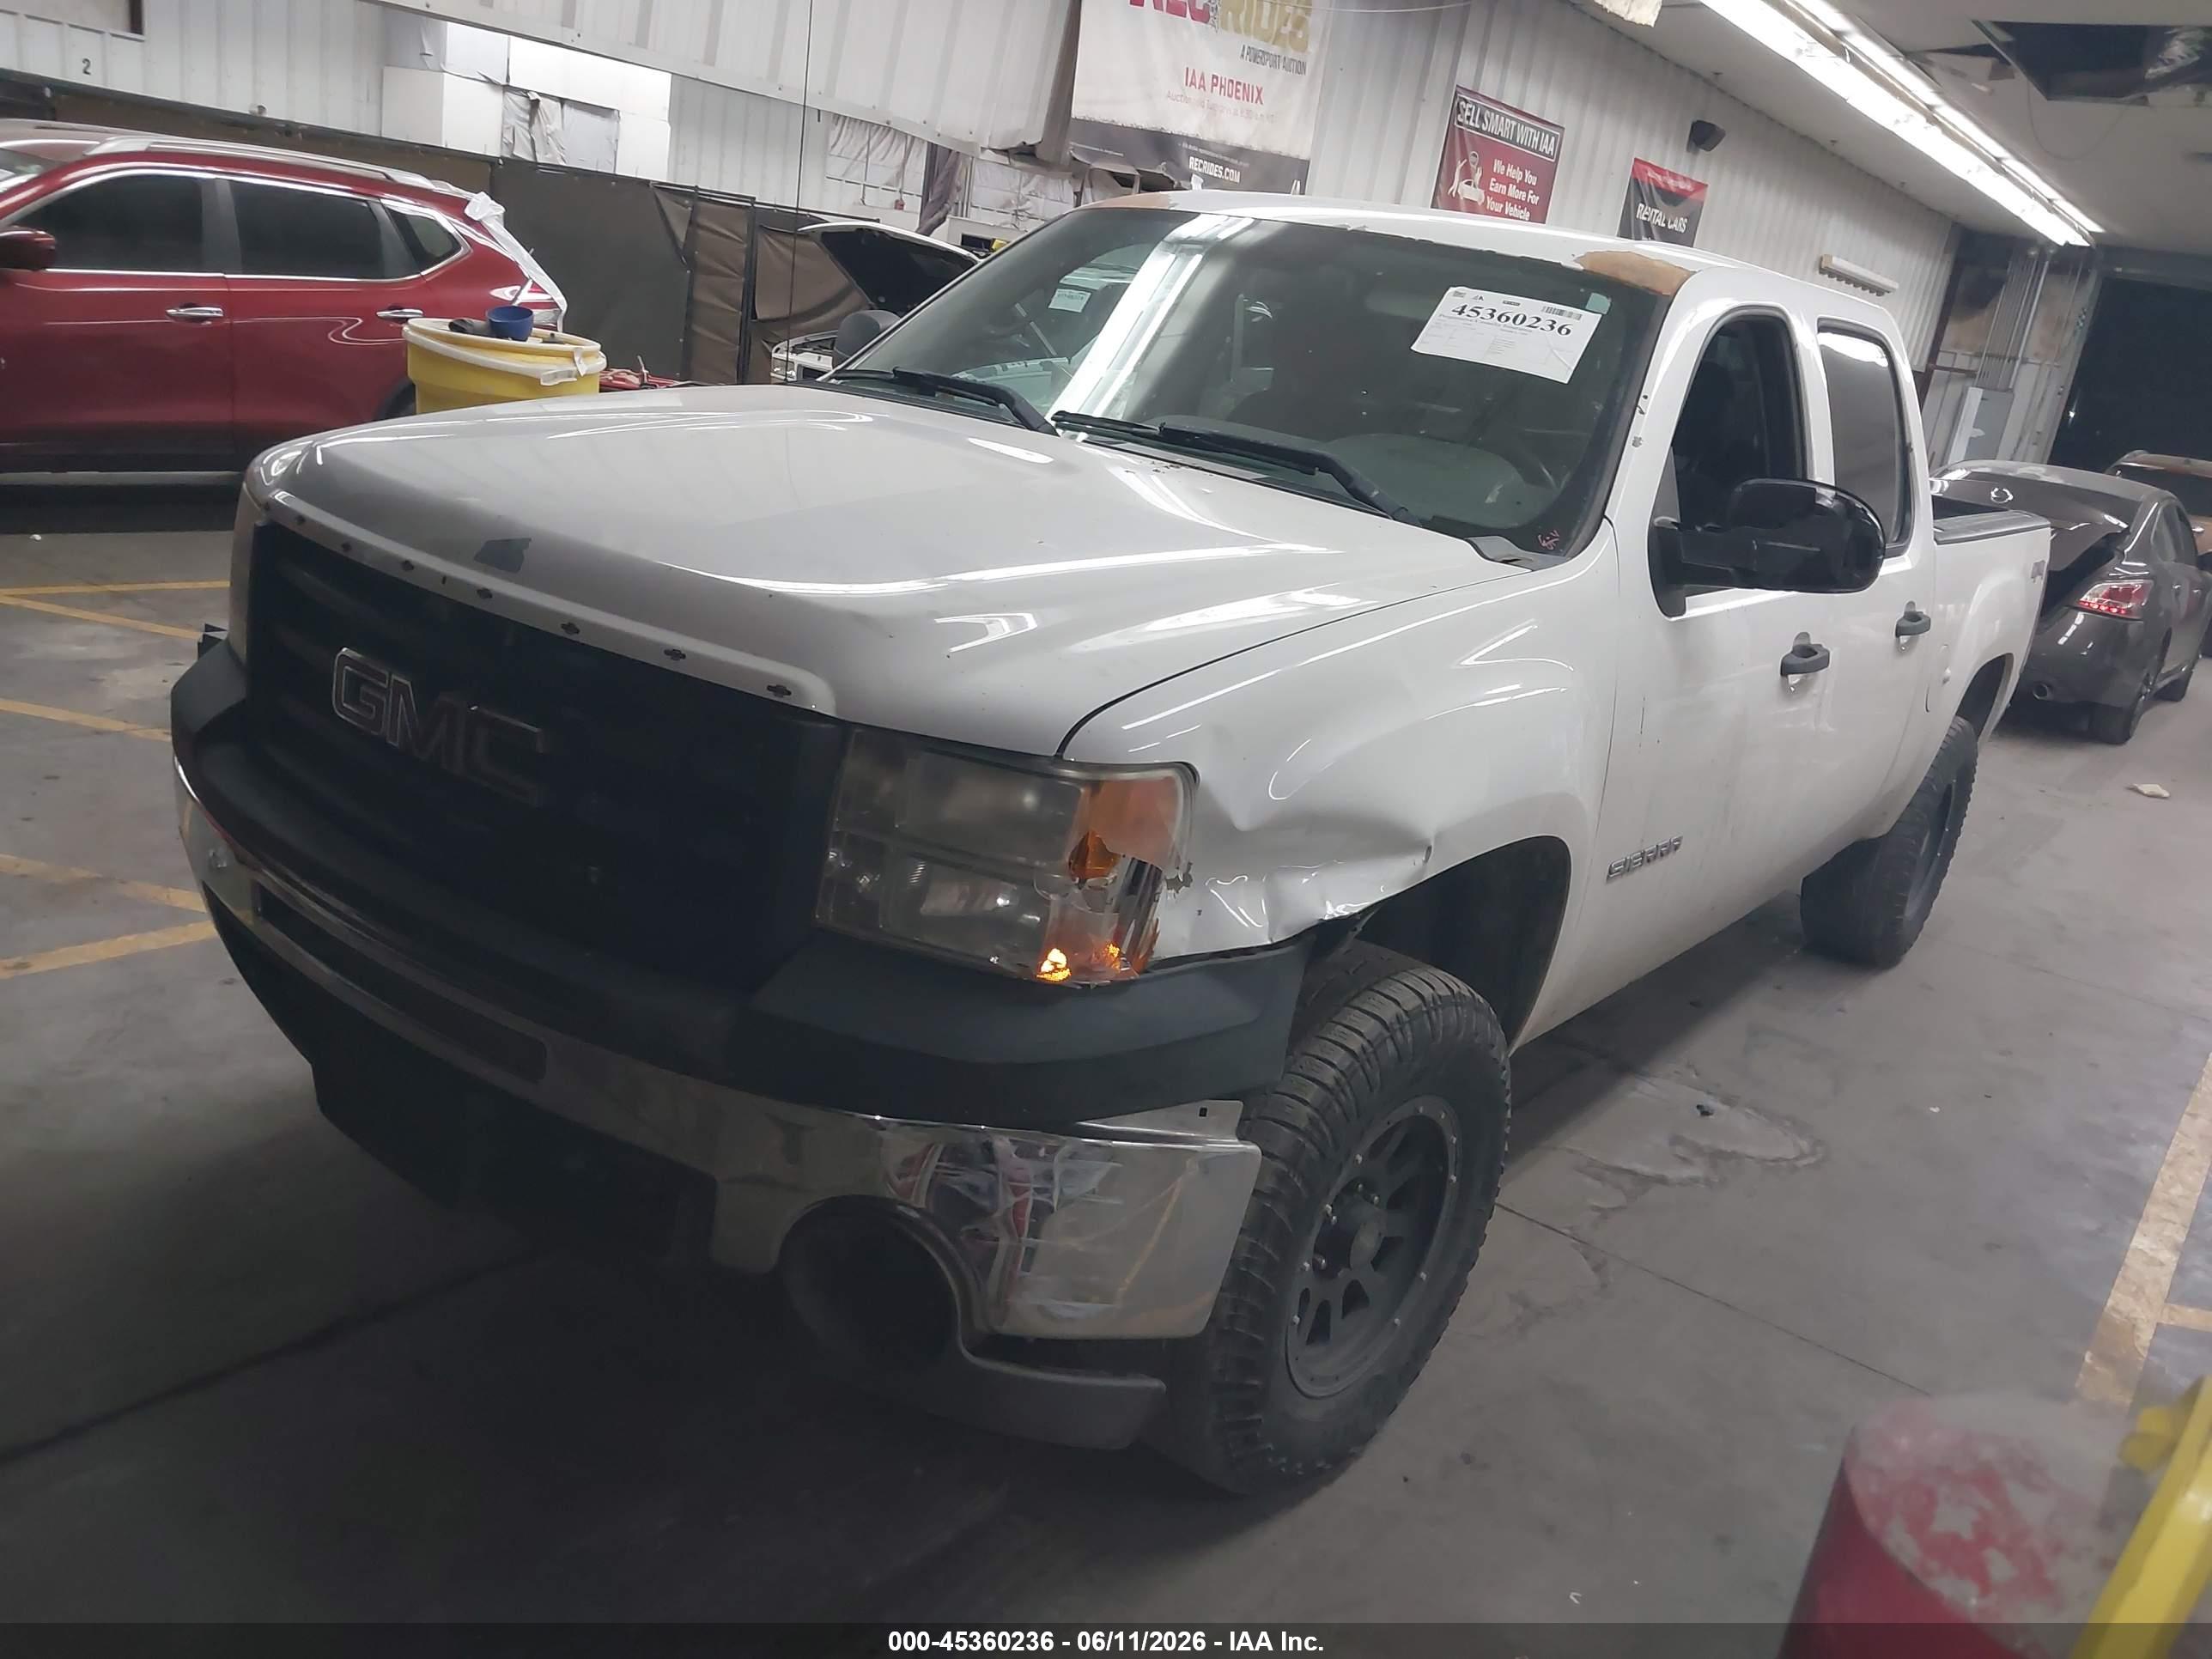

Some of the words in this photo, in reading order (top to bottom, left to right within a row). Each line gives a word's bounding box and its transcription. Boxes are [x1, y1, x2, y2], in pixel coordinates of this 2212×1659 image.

[82, 58, 91, 76] 2
[1282, 56, 1306, 76] AUCTION
[1185, 67, 1206, 92] IAA
[1211, 74, 1264, 105] PHOENIX
[1457, 101, 1480, 129] SELL
[1482, 111, 1517, 140] SMART
[1516, 123, 1540, 150] WITH
[1540, 132, 1555, 156] IAA
[1188, 155, 1241, 183] RECRIDES.COM
[1493, 159, 1504, 175] We
[1507, 163, 1522, 182] Help
[1524, 168, 1537, 185] You
[1490, 178, 1506, 195] Earn
[1508, 183, 1526, 201] More
[1528, 190, 1540, 205] For
[1486, 196, 1504, 214] Your
[1504, 201, 1530, 222] Vehicle
[1636, 203, 1666, 228] RENTAL
[1451, 304, 1573, 337] 45360236
[331, 647, 549, 808] GMC
[1605, 836, 1683, 883] SIERRA
